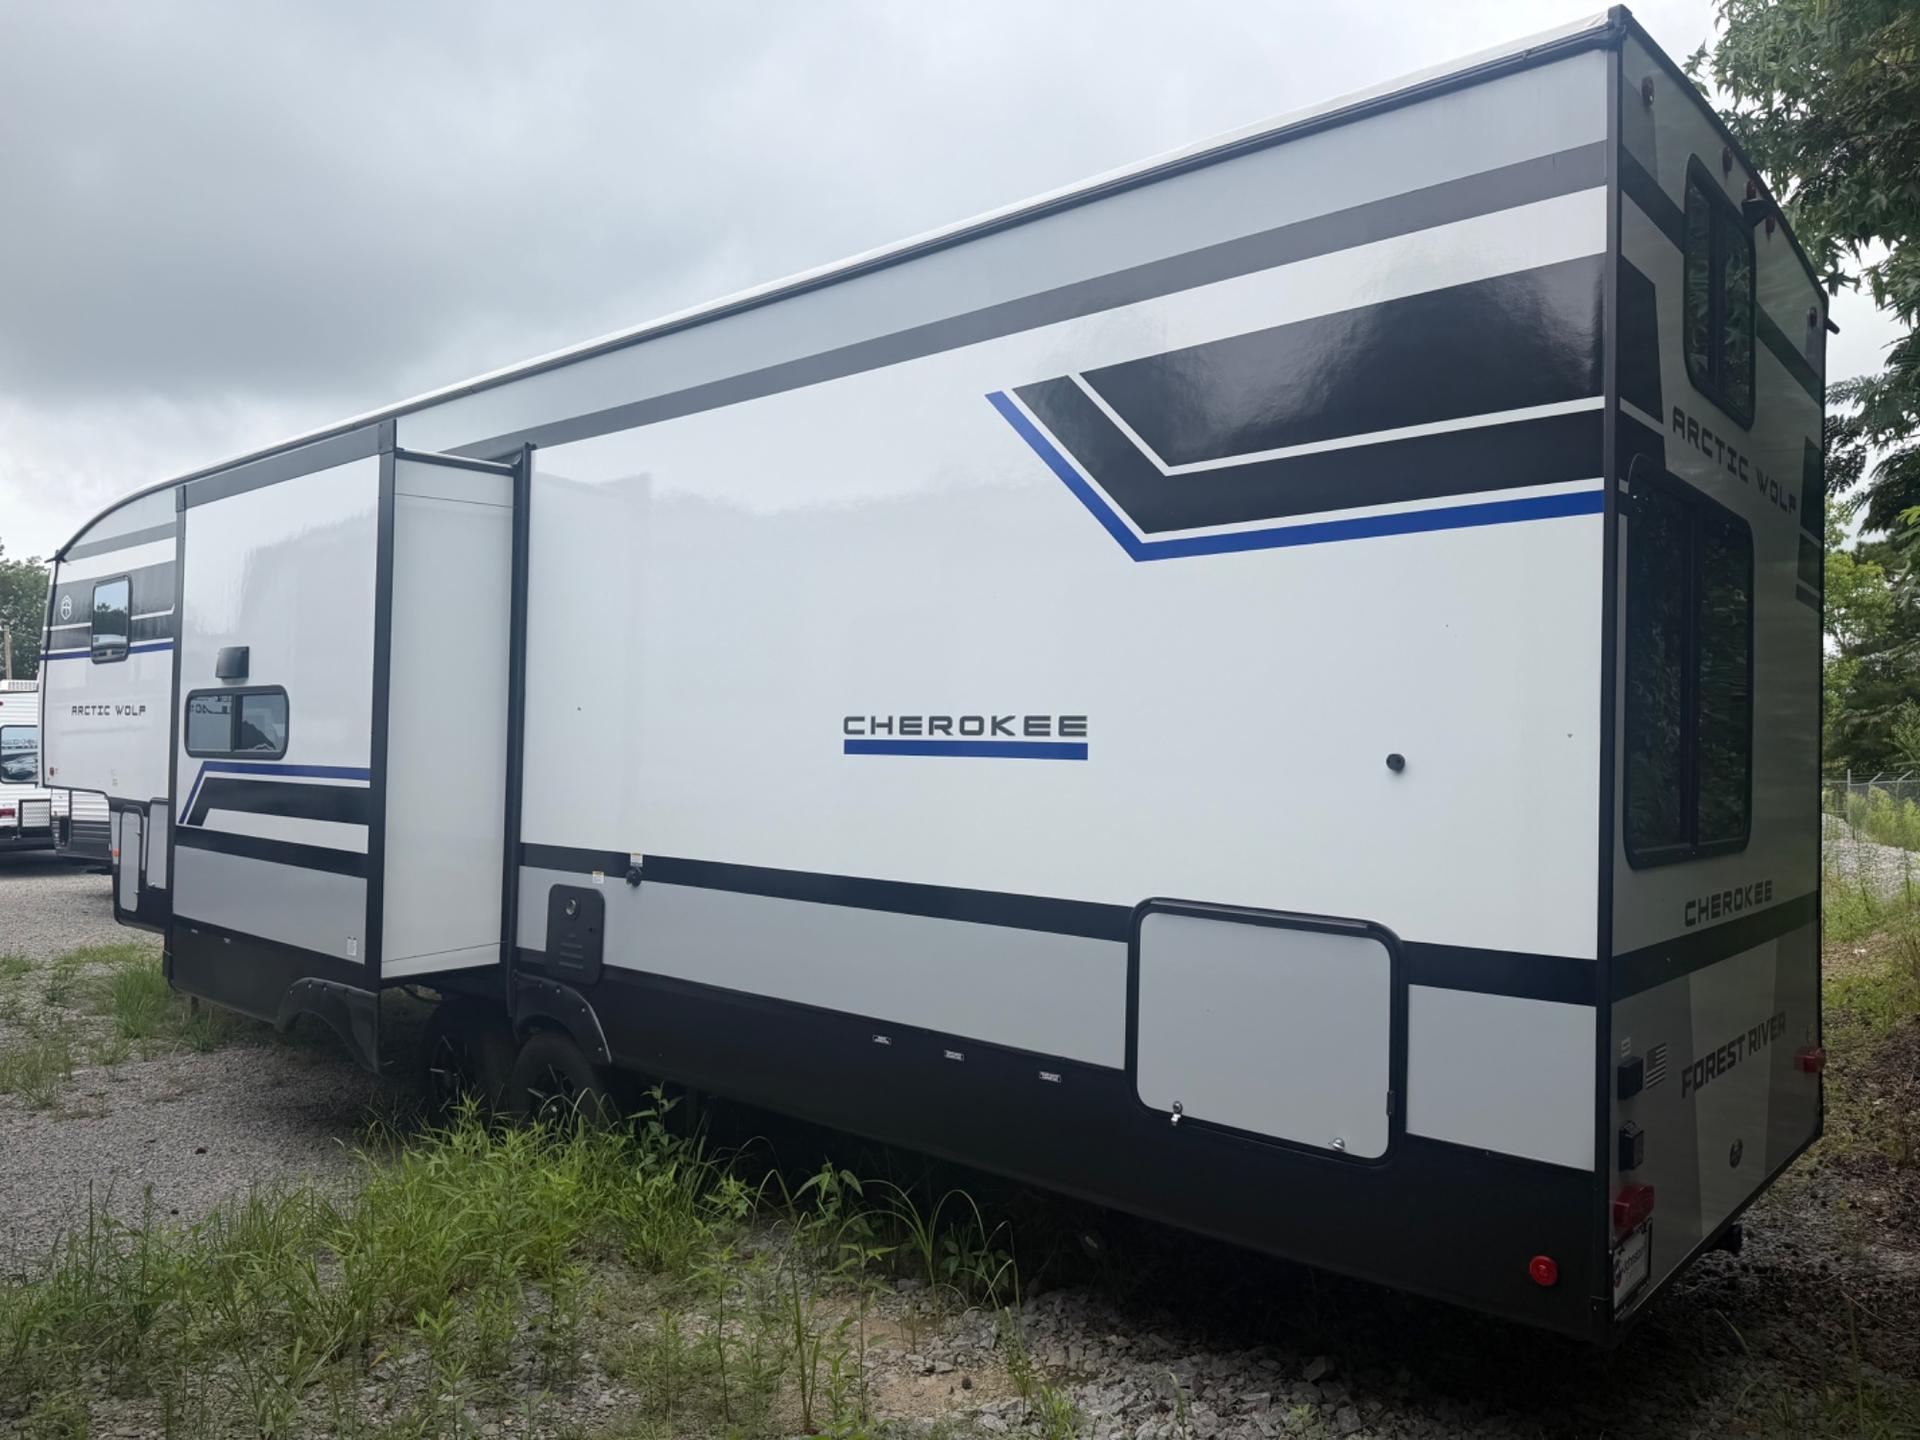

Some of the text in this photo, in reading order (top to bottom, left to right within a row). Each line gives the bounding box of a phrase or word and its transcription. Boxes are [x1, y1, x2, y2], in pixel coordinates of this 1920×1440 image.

[1672, 405, 1797, 515] ARCTIC WOLF
[71, 705, 146, 716] ARCTIC WOLF
[843, 715, 1087, 737] CHEROKEE
[1684, 879, 1773, 927] CHEROKEE
[1681, 1010, 1787, 1099] FOREST RIVER
